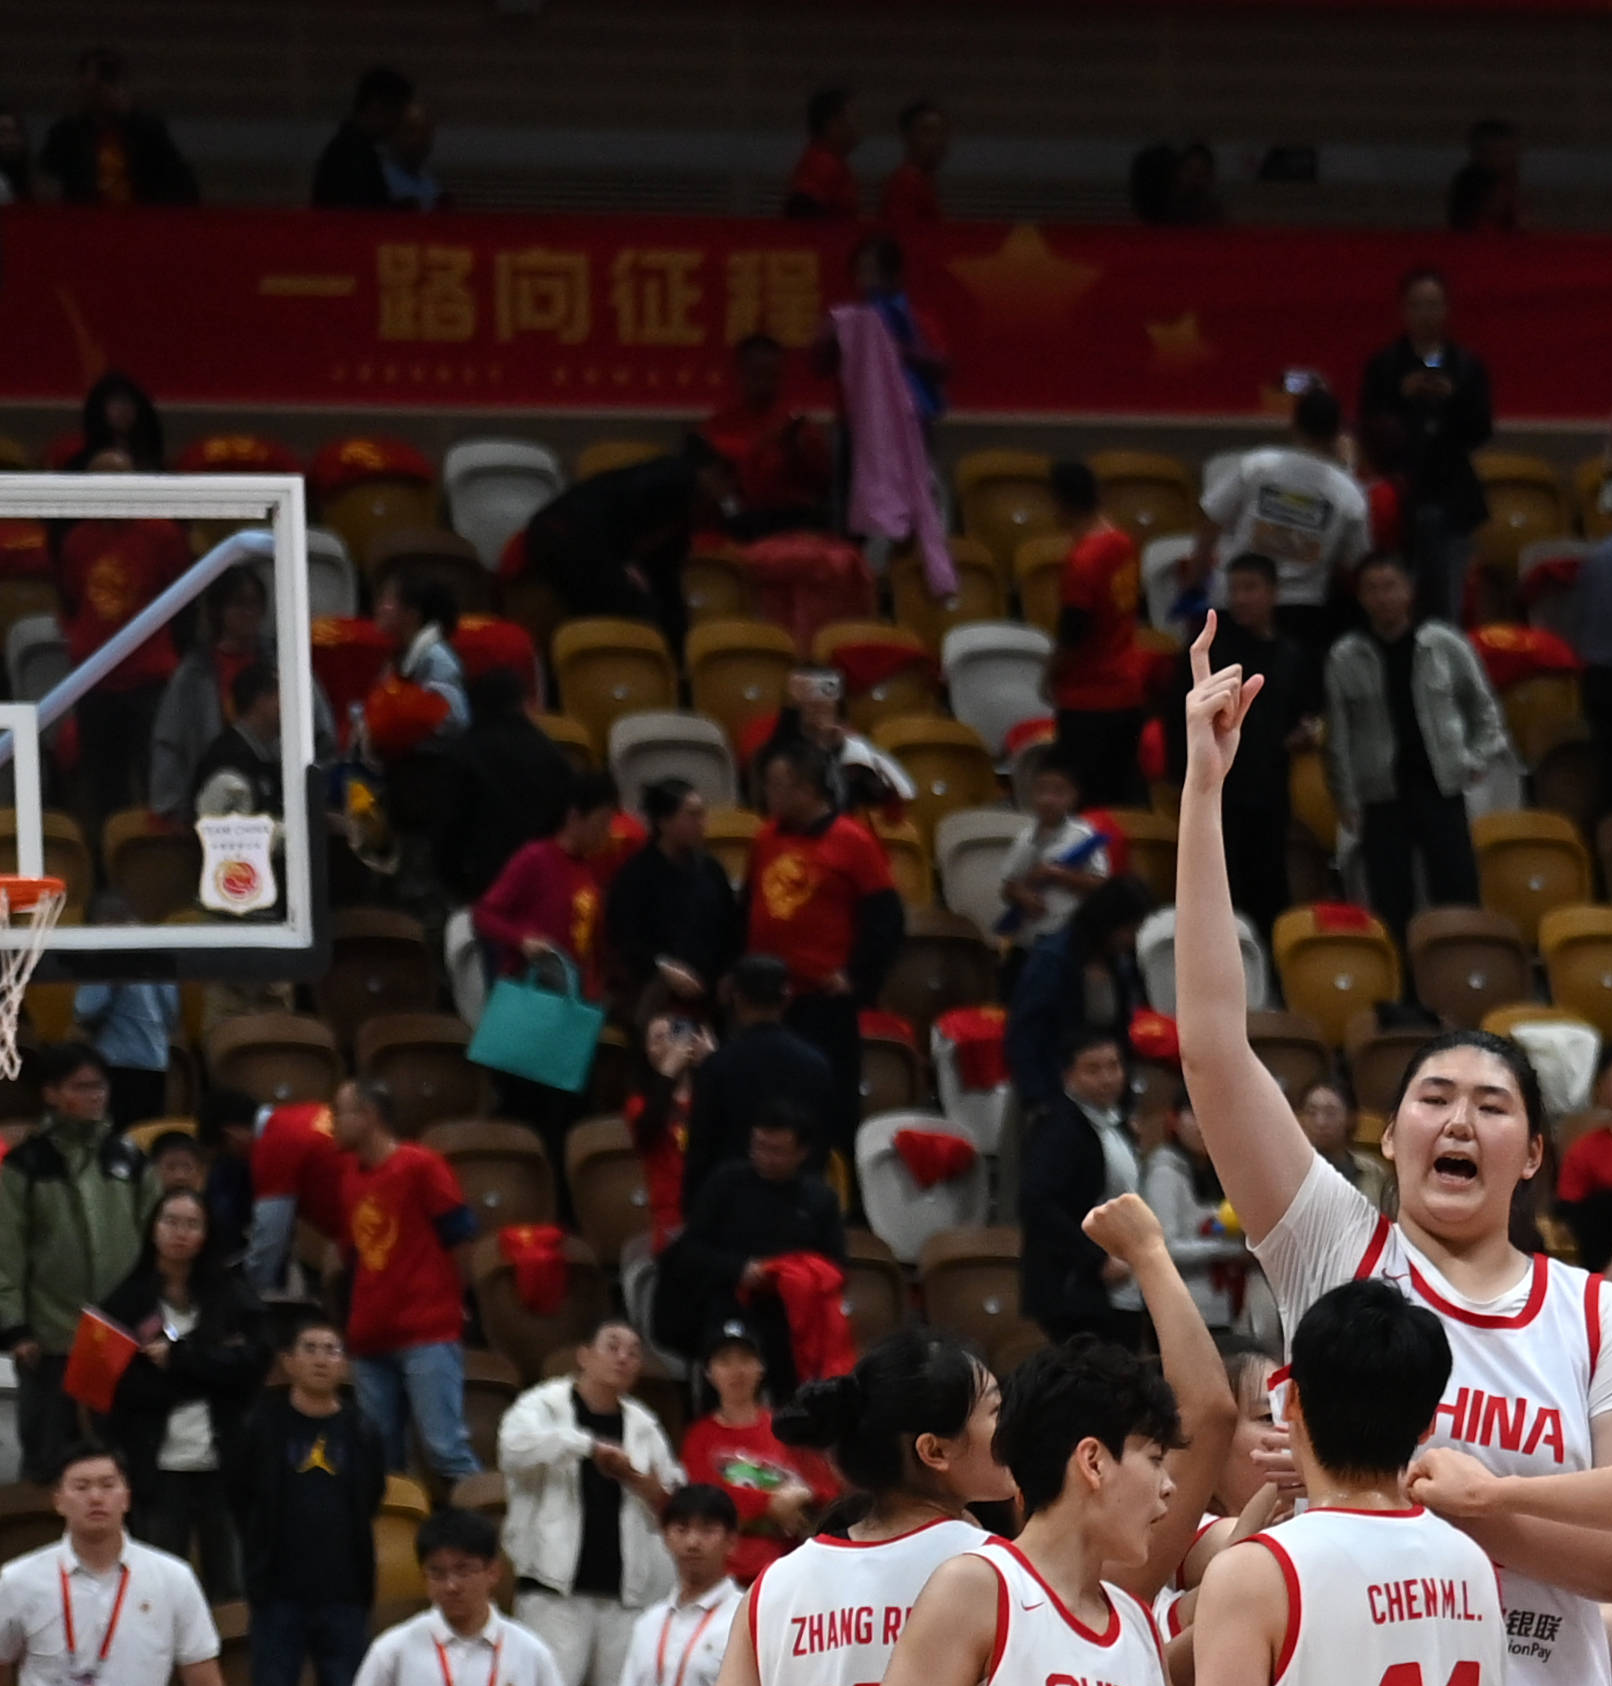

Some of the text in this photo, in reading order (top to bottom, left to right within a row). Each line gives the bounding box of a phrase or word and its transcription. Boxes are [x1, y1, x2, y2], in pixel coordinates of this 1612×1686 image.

[258, 243, 824, 348] 一路向征程
[1432, 1386, 1565, 1464] HINA
[791, 1606, 874, 1657] ZHANG
[1506, 1609, 1562, 1642] 银联
[1508, 1640, 1552, 1664] ionPay
